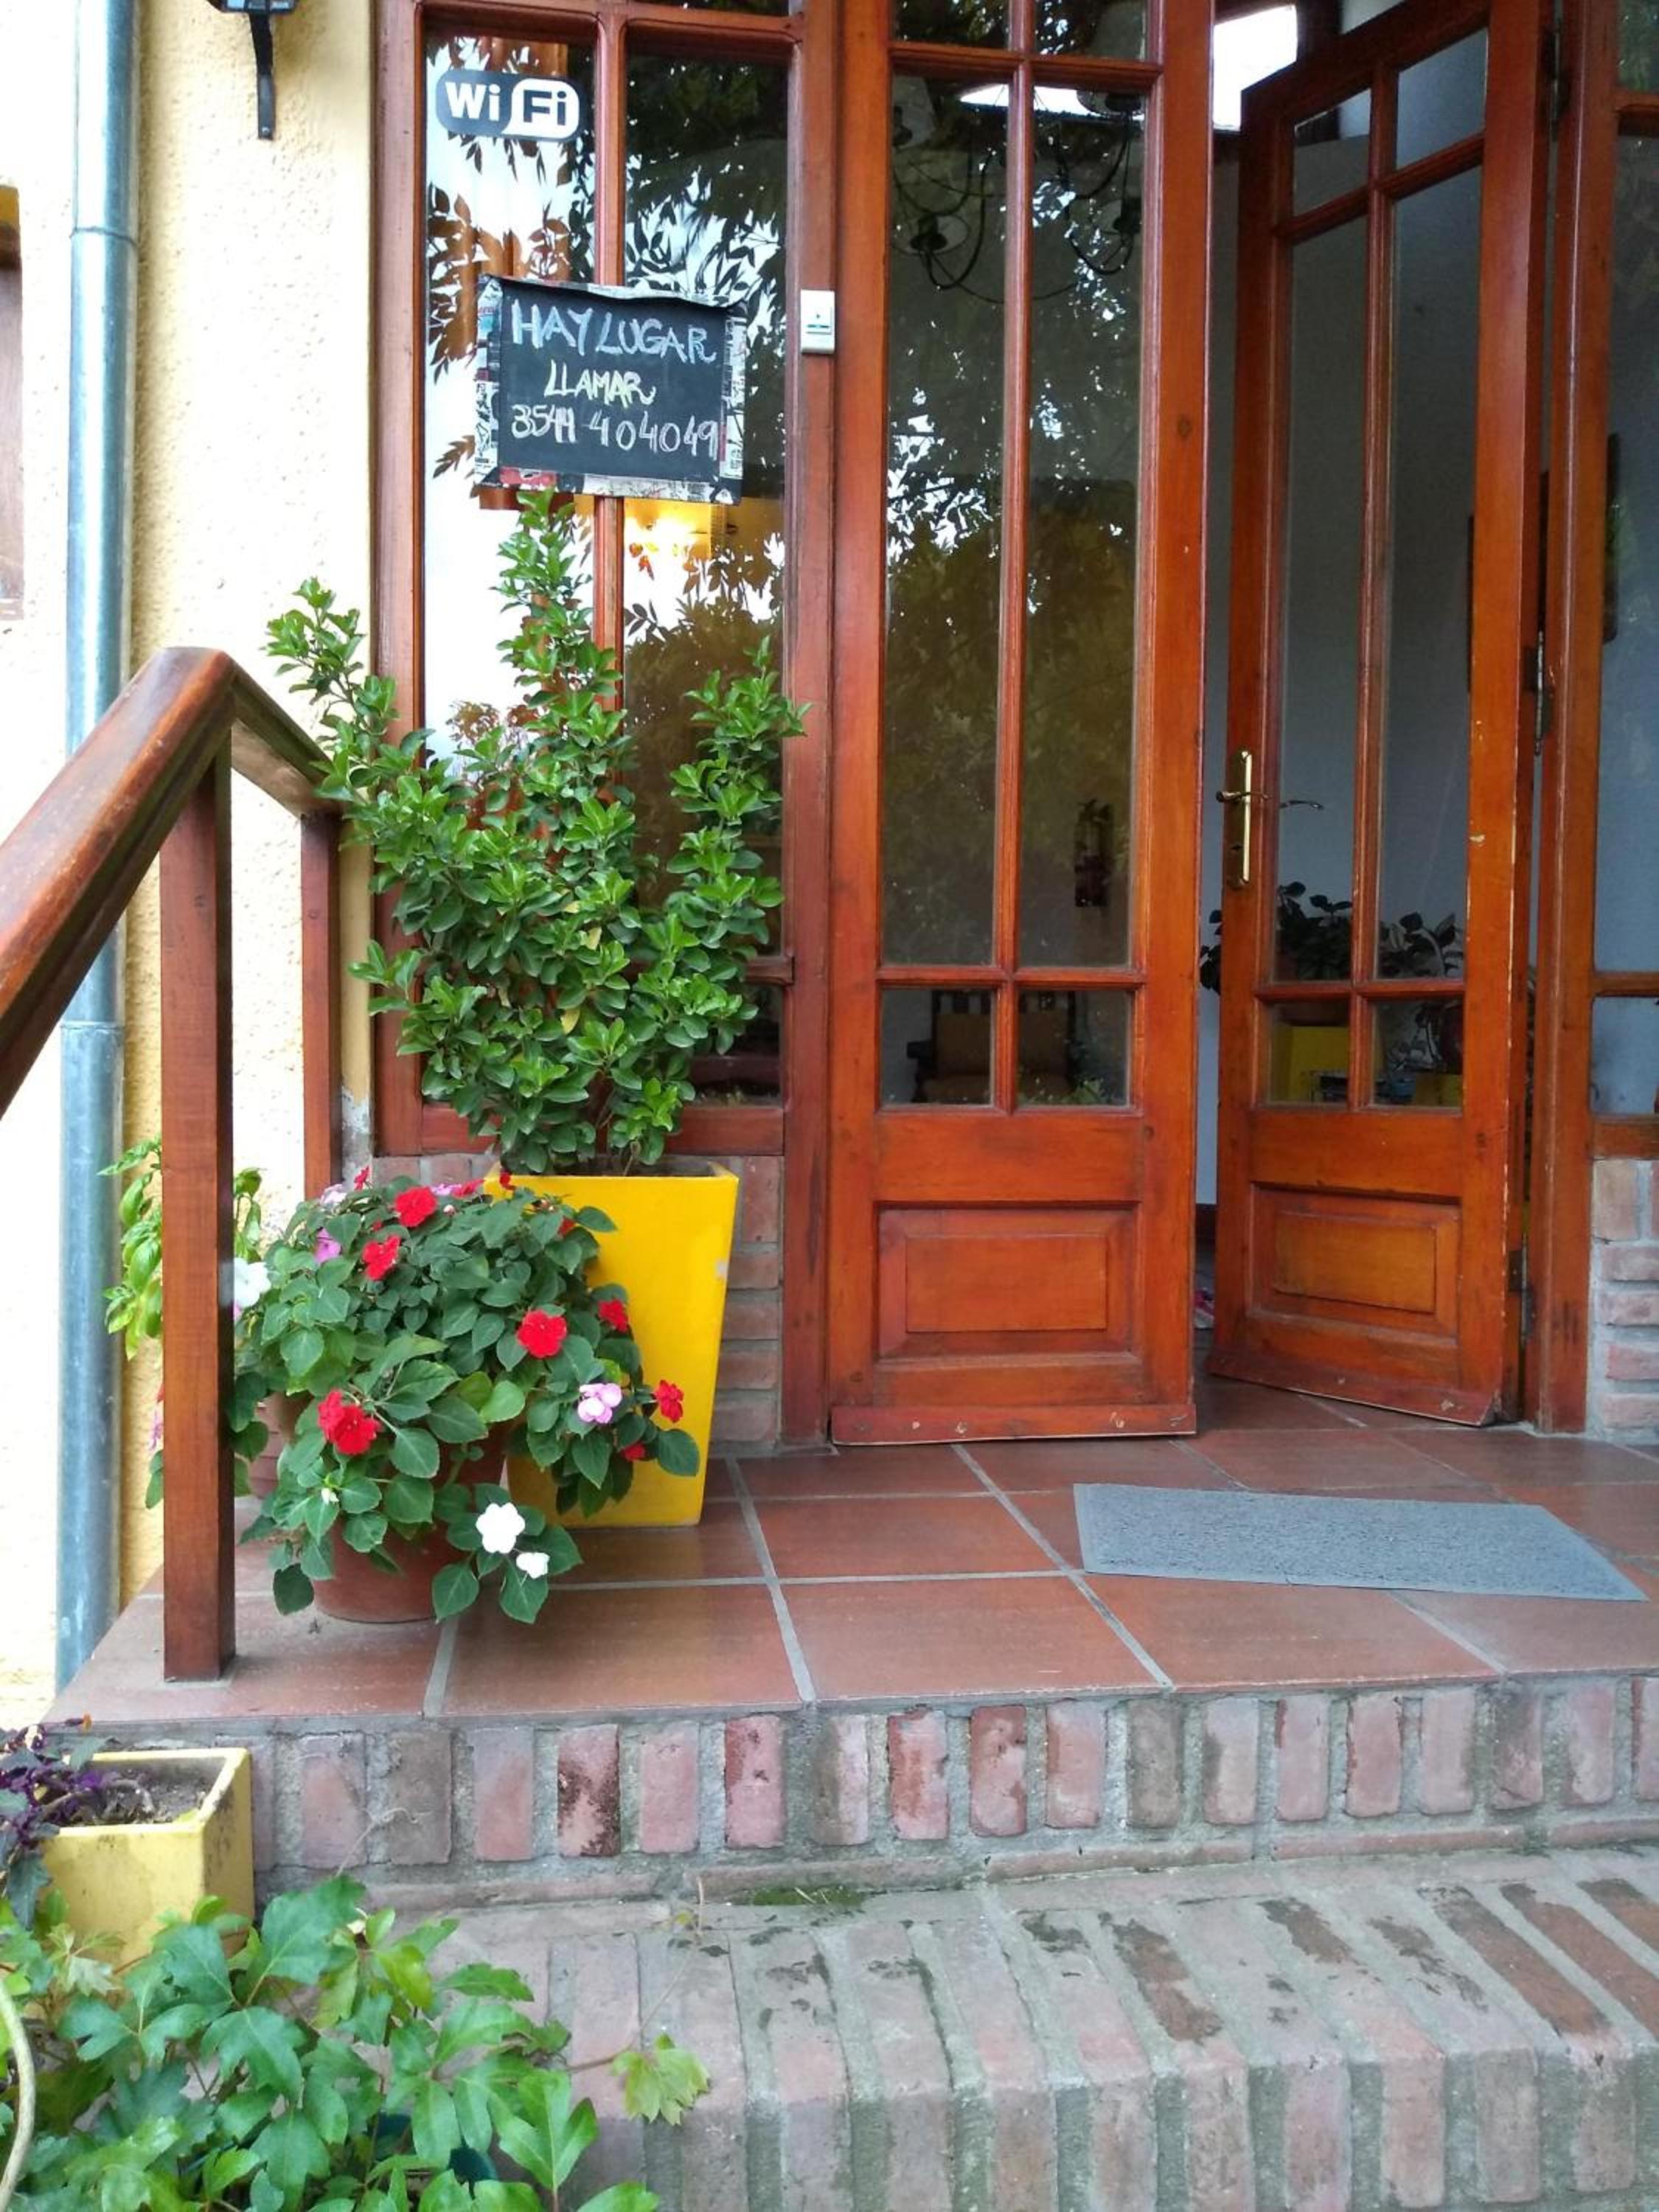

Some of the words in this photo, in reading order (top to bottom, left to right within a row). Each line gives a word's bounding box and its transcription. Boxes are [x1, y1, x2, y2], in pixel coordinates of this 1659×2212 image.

[512, 298, 593, 356] HAY
[595, 311, 717, 365] LUGAR
[543, 359, 656, 408] LLAMAR
